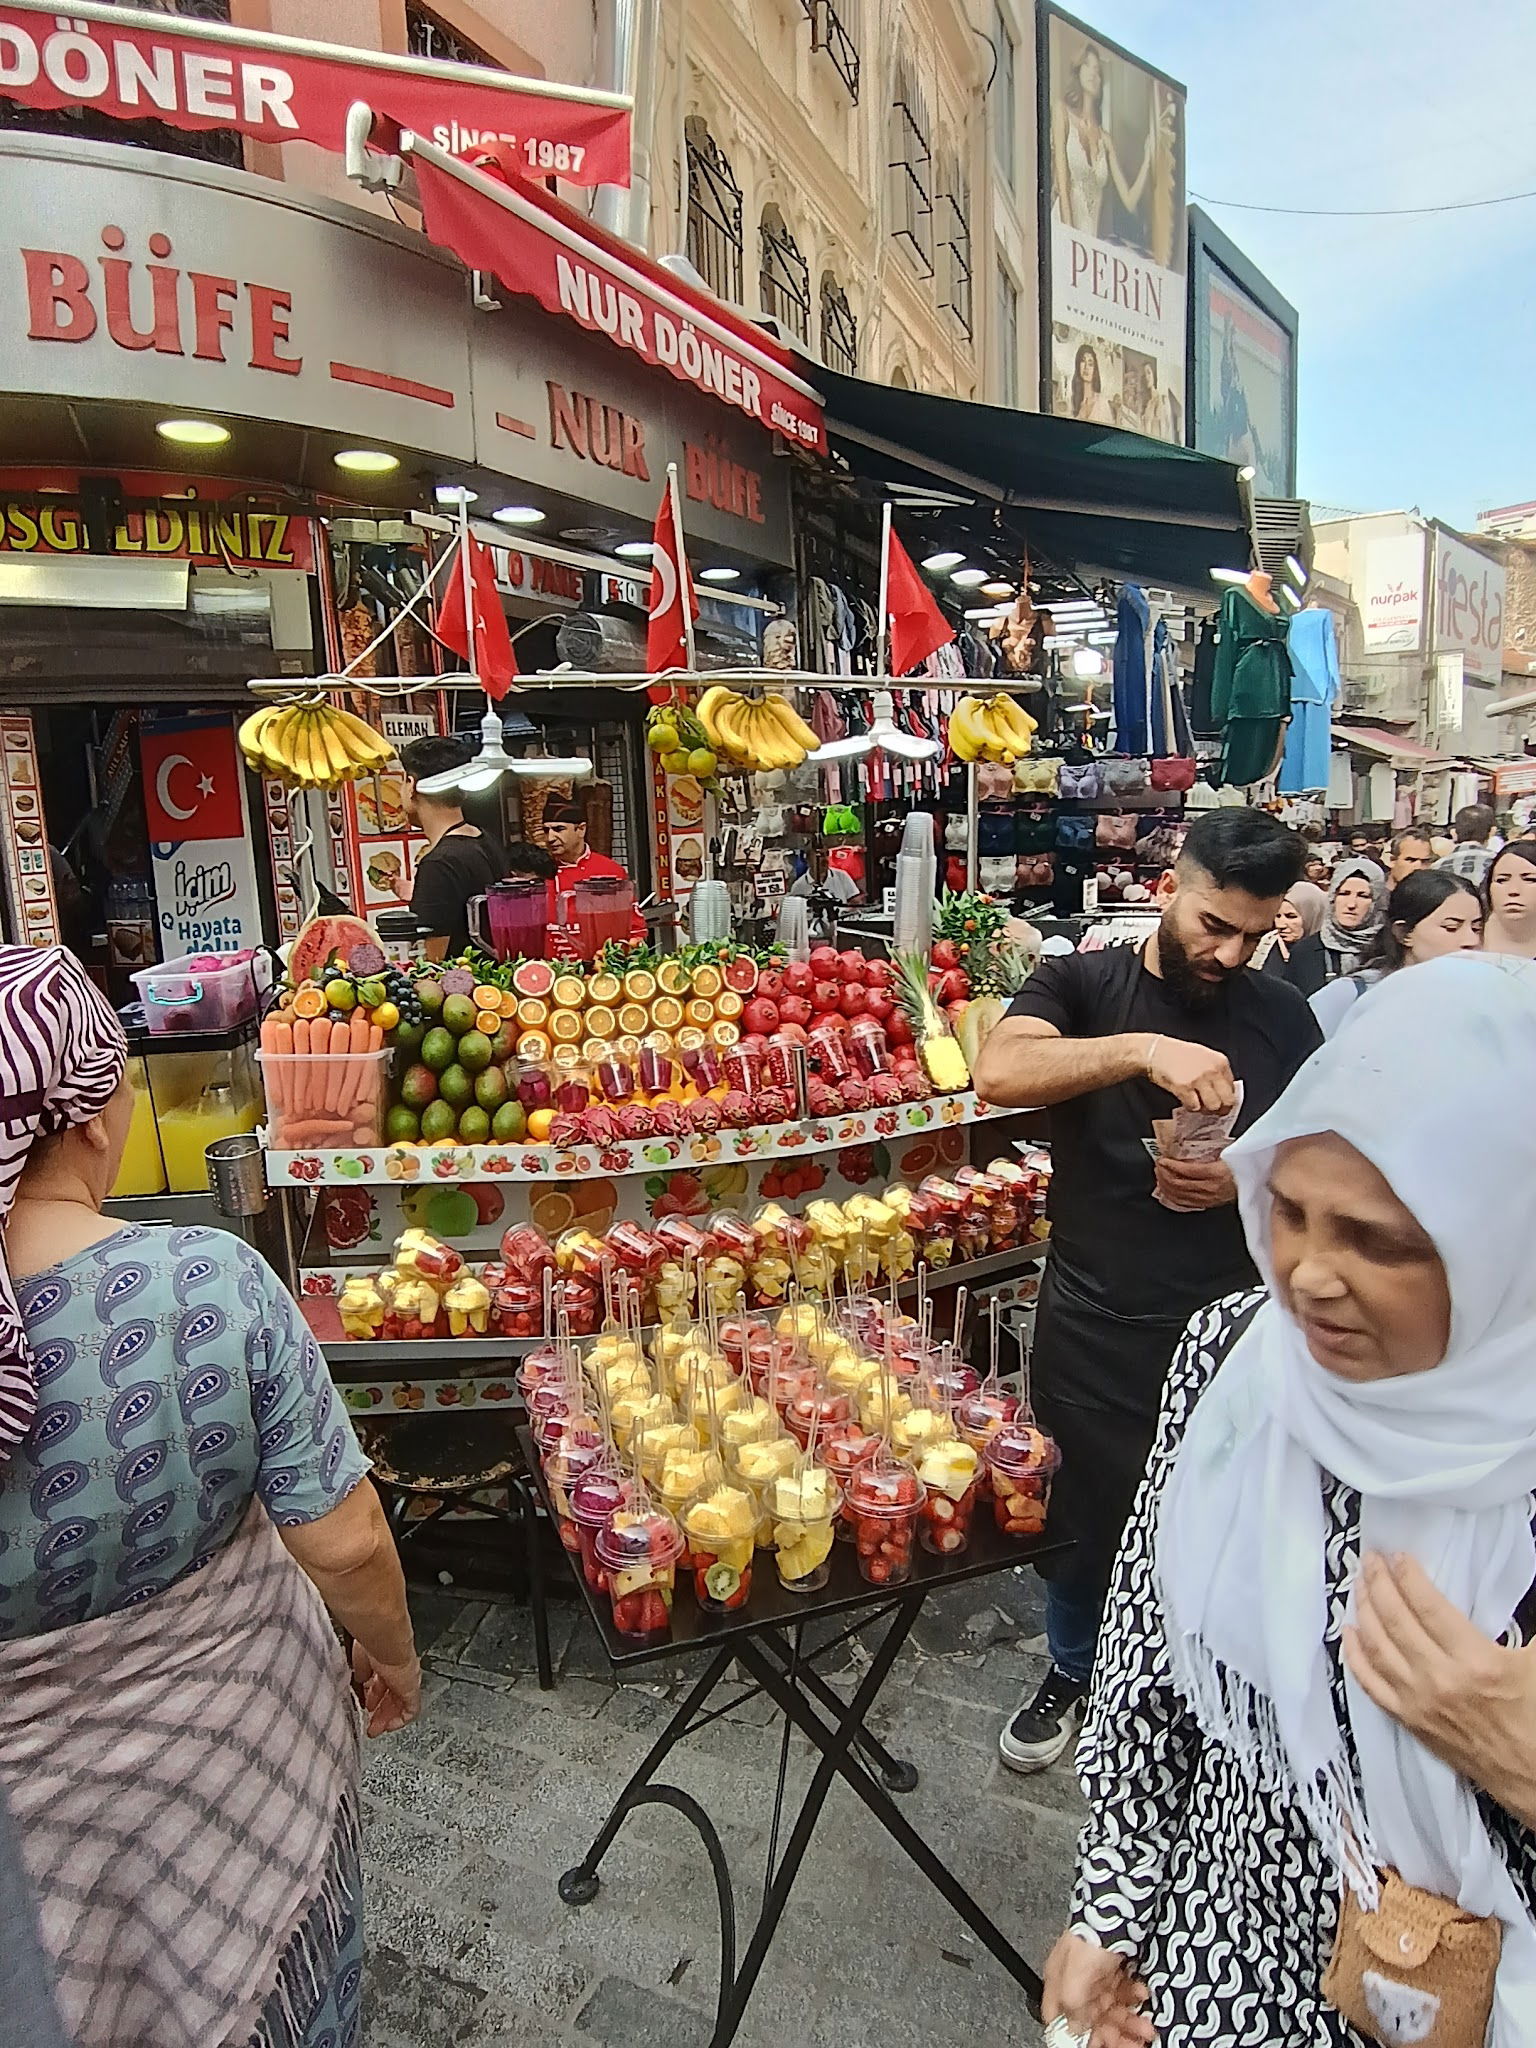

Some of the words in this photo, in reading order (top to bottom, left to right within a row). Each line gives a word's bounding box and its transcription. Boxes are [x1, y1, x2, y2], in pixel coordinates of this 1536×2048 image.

[0, 16, 300, 130] DÖNER
[523, 137, 585, 172] 1987
[20, 224, 304, 376] BÜFE
[556, 254, 648, 352] NUR
[654, 319, 762, 416] DÖNER
[546, 380, 650, 482] NUR
[682, 430, 766, 524] BÜFE
[1371, 590, 1418, 606] nurpak
[1438, 551, 1502, 651] fiesta
[178, 916, 242, 941] Hayata
